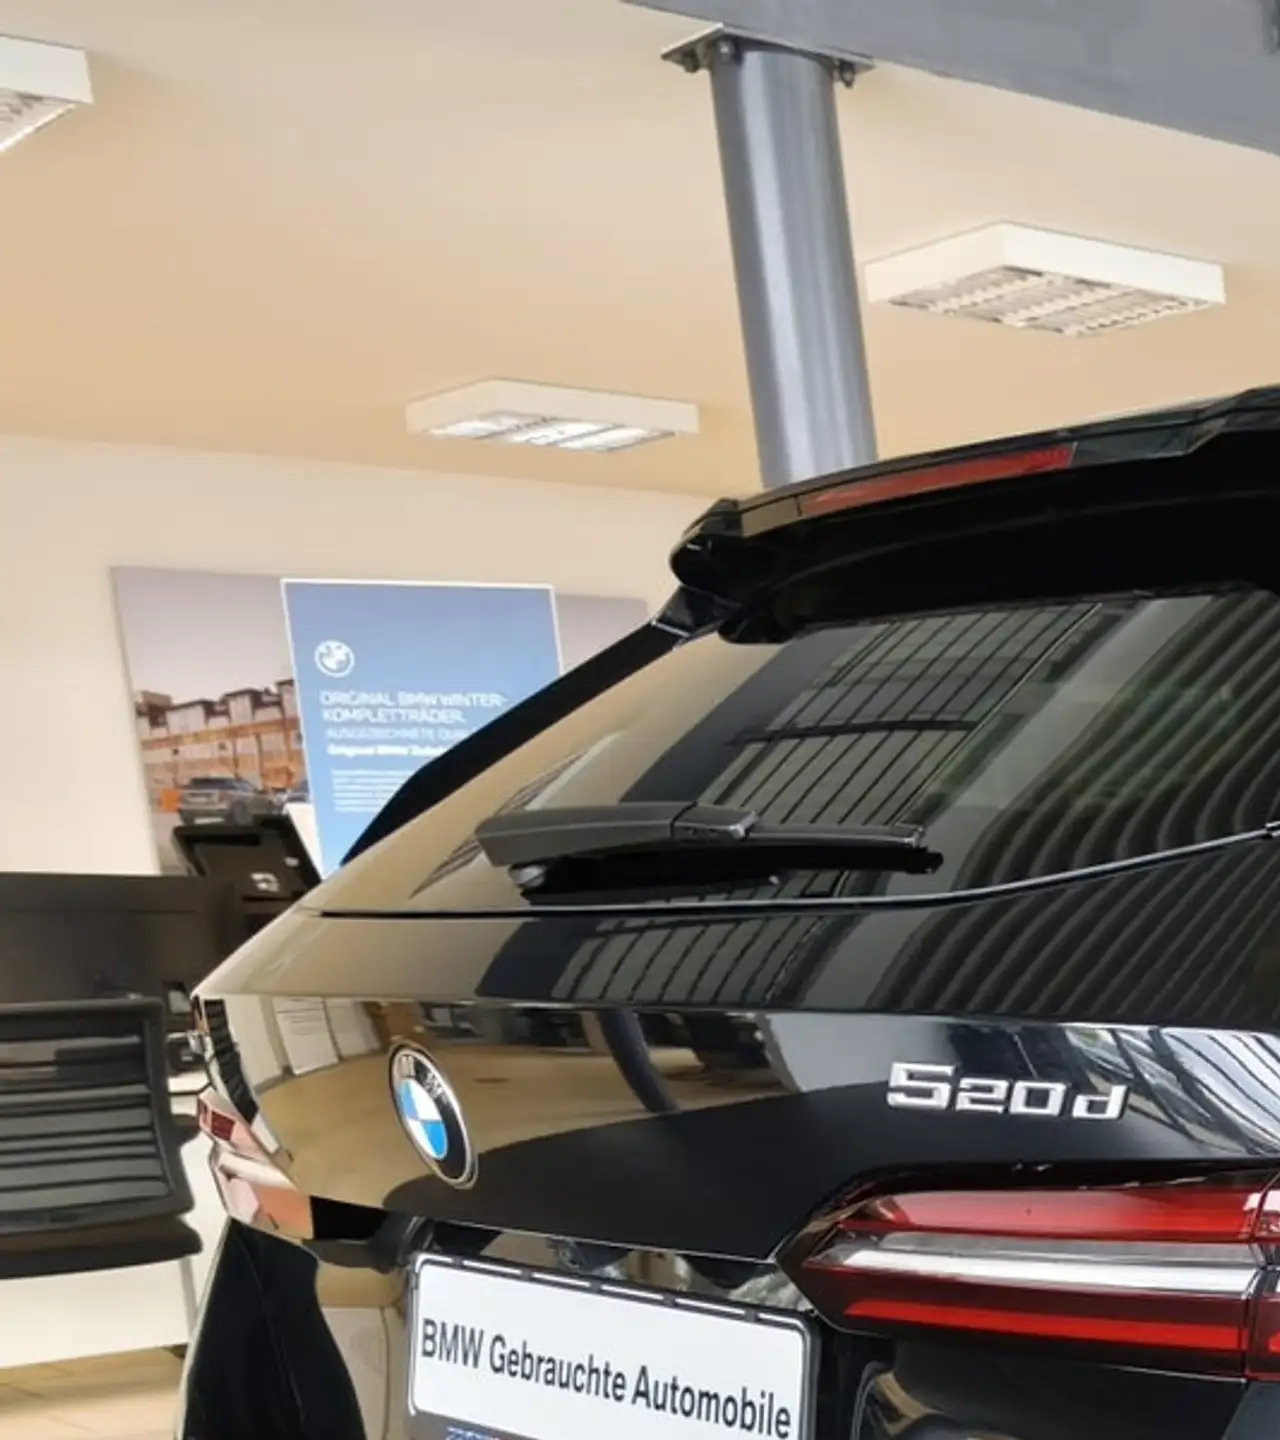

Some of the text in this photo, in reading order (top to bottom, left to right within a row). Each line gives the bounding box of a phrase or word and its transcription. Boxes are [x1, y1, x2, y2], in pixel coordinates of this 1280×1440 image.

[319, 690, 396, 707] ORIGINAL
[421, 1317, 792, 1440] BMW Gebrauchte Automobile
